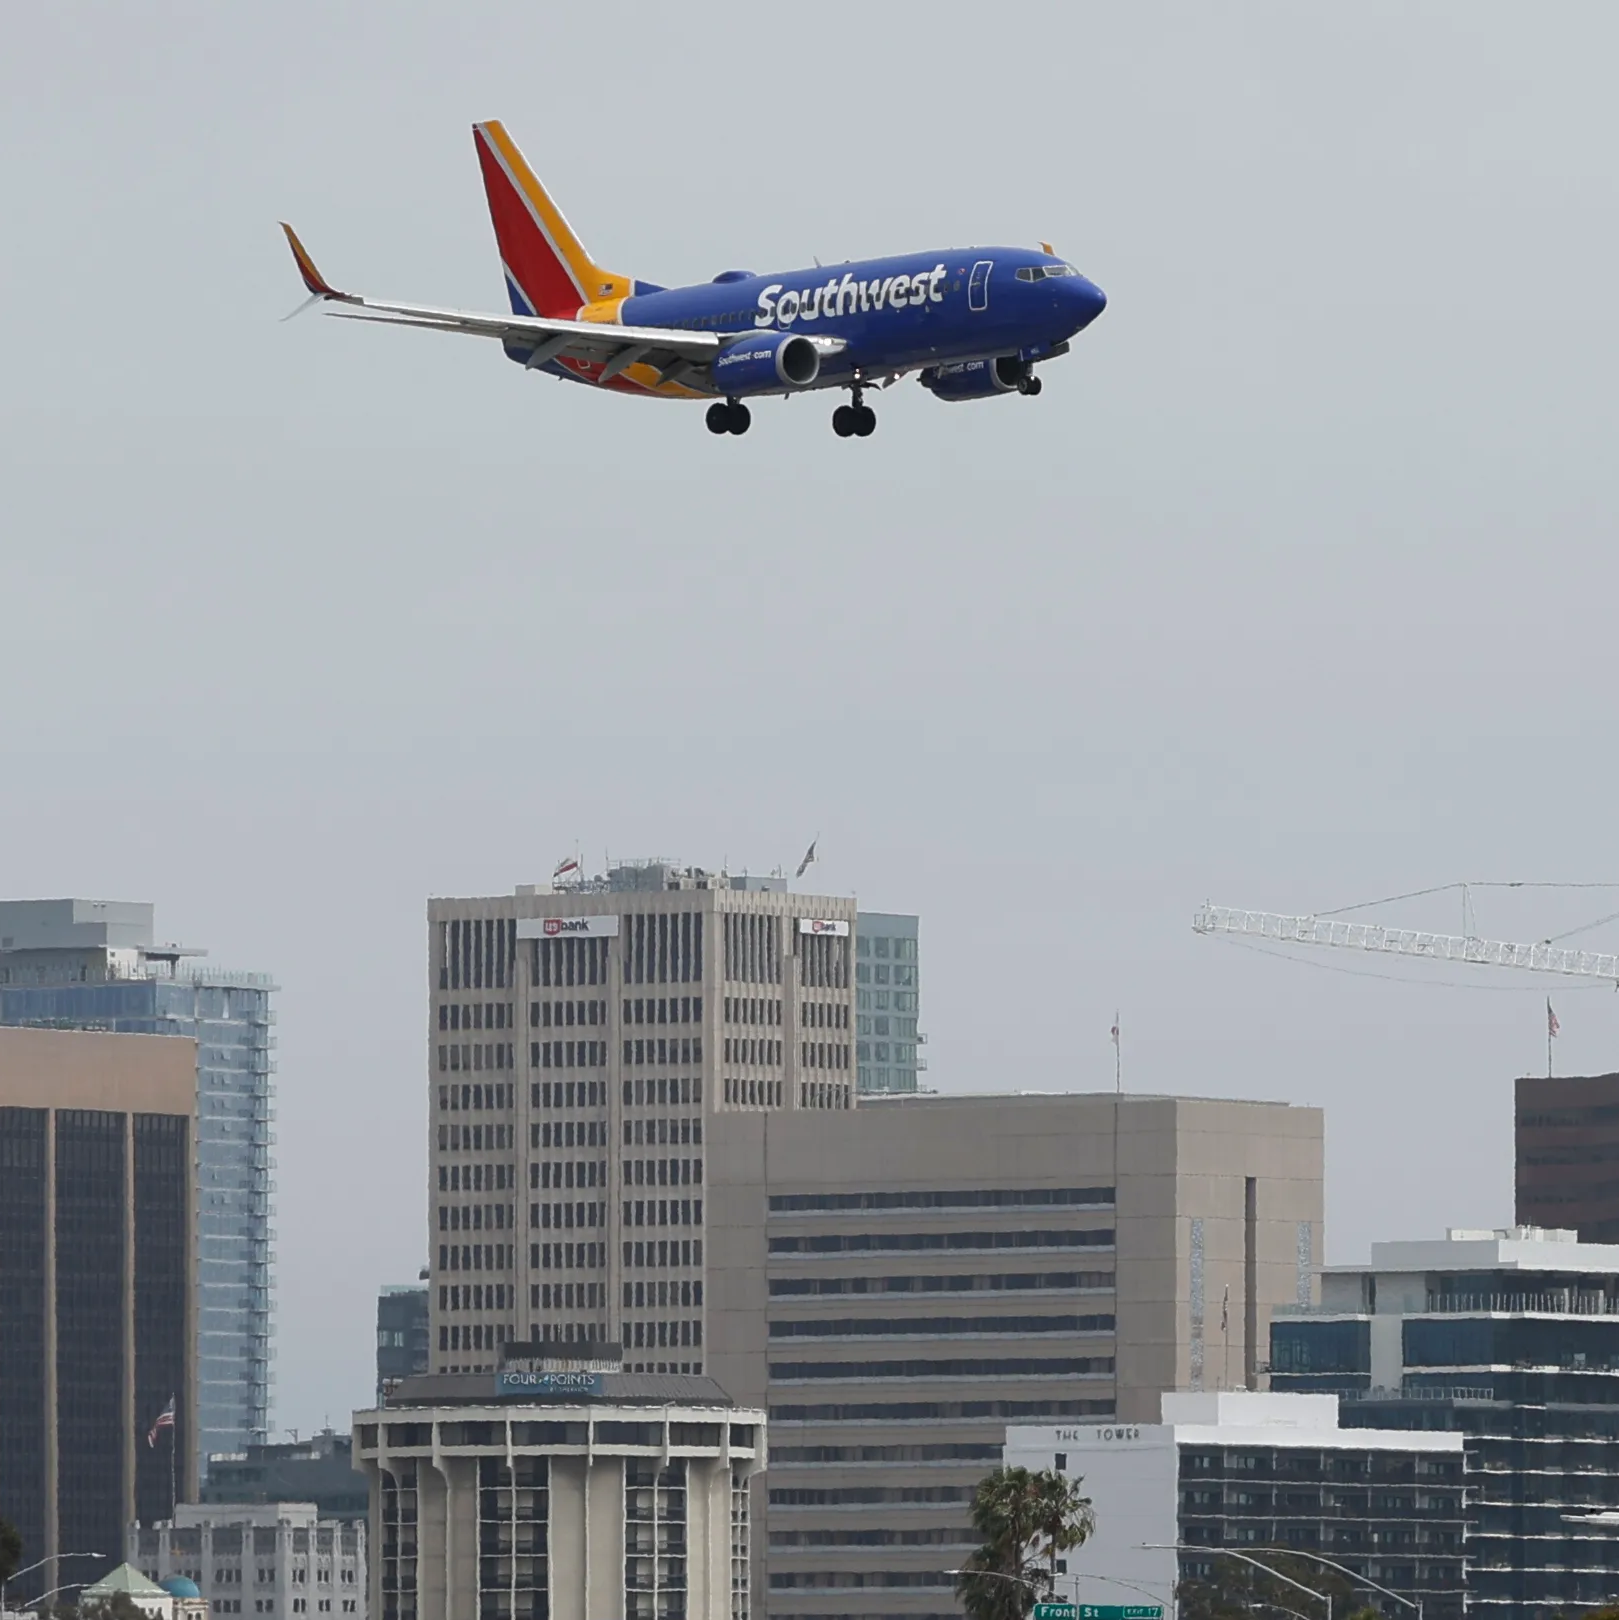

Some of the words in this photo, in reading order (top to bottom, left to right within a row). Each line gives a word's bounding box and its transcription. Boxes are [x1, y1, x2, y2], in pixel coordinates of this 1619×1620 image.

[754, 264, 947, 327] Southwest
[503, 1374, 536, 1385] FOUR
[550, 1374, 595, 1386] POINTS
[1055, 1430, 1078, 1441] THE
[1097, 1428, 1140, 1441] TOWER
[1041, 1606, 1076, 1618] Front
[1084, 1607, 1099, 1618] St
[1148, 1607, 1158, 1616] 17
